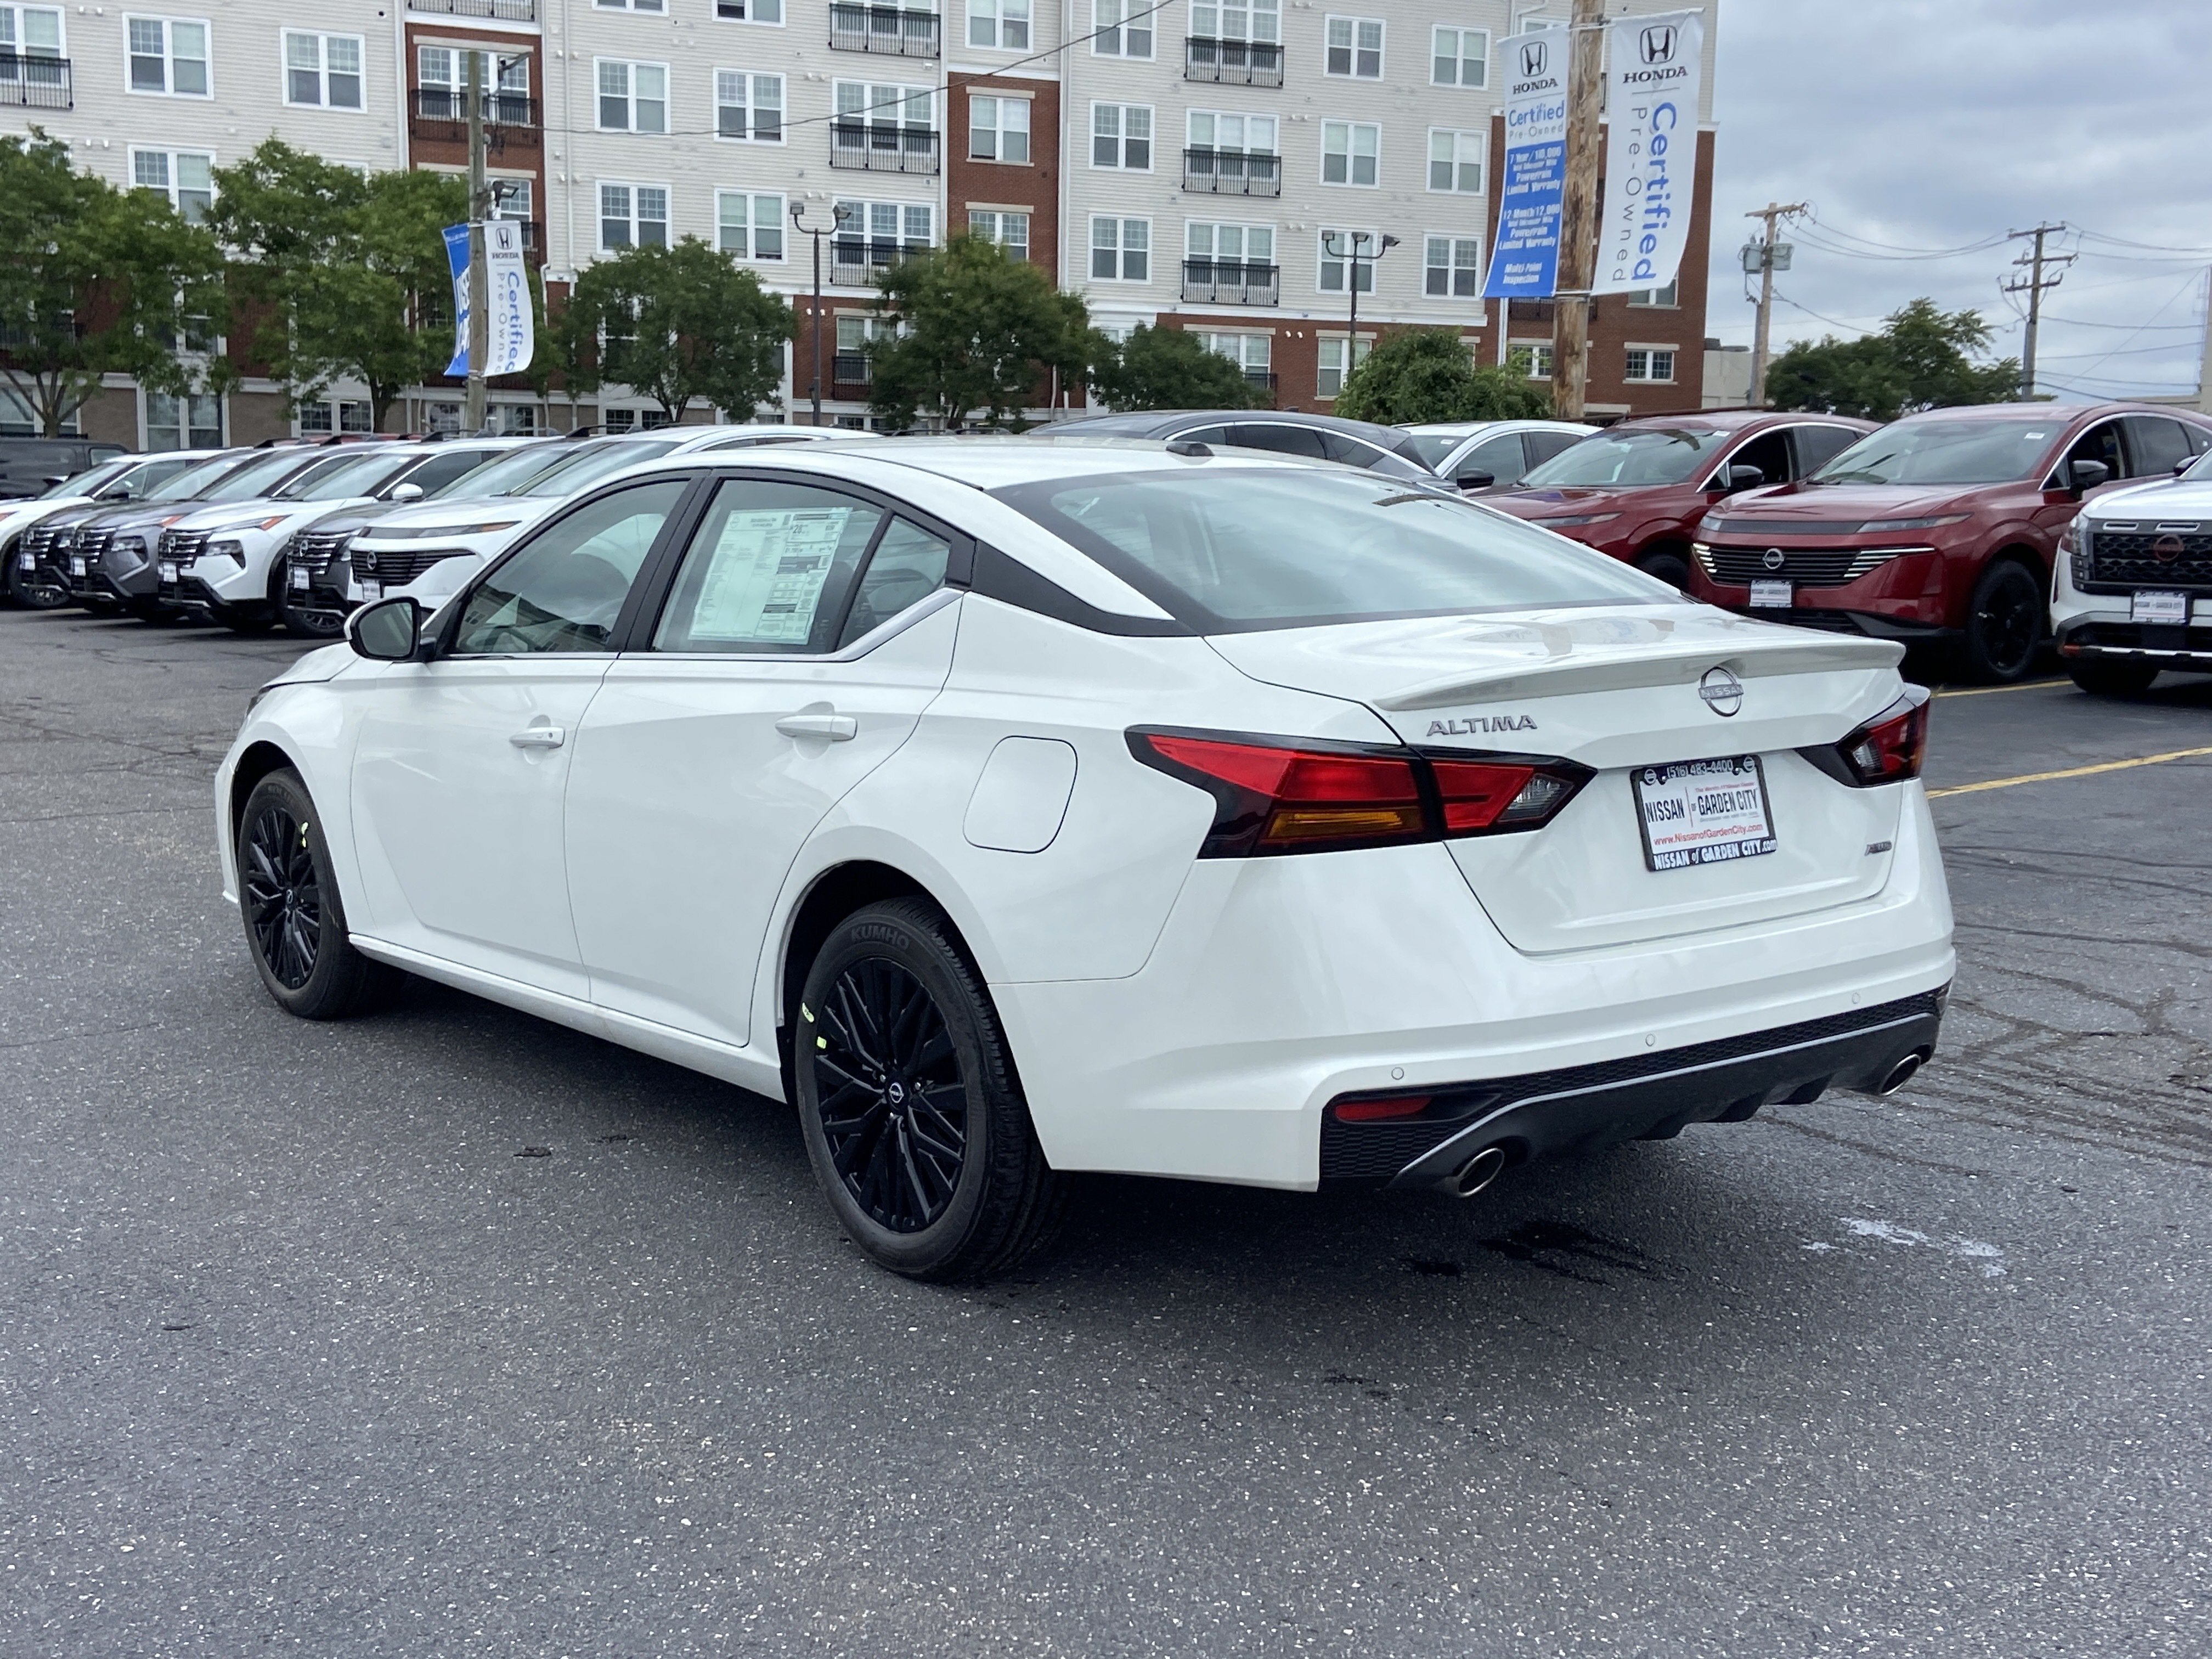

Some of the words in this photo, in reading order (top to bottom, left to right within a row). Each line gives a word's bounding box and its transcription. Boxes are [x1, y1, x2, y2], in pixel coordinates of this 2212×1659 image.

[1513, 78, 1558, 94] HONDA
[1623, 66, 1688, 83] HONDA
[1509, 100, 1565, 127] Certified
[1612, 108, 1647, 281] Pre-Owned
[1631, 102, 1677, 280] Certified
[1427, 715, 1537, 737] ALTIMA
[1645, 798, 1685, 823] NISSAN
[1697, 791, 1736, 816] GARDEN
[1736, 788, 1757, 810] CITY
[1654, 850, 1690, 870] NISSAN
[1701, 843, 1740, 862] GARDEN
[851, 925, 910, 950] KUMHO
